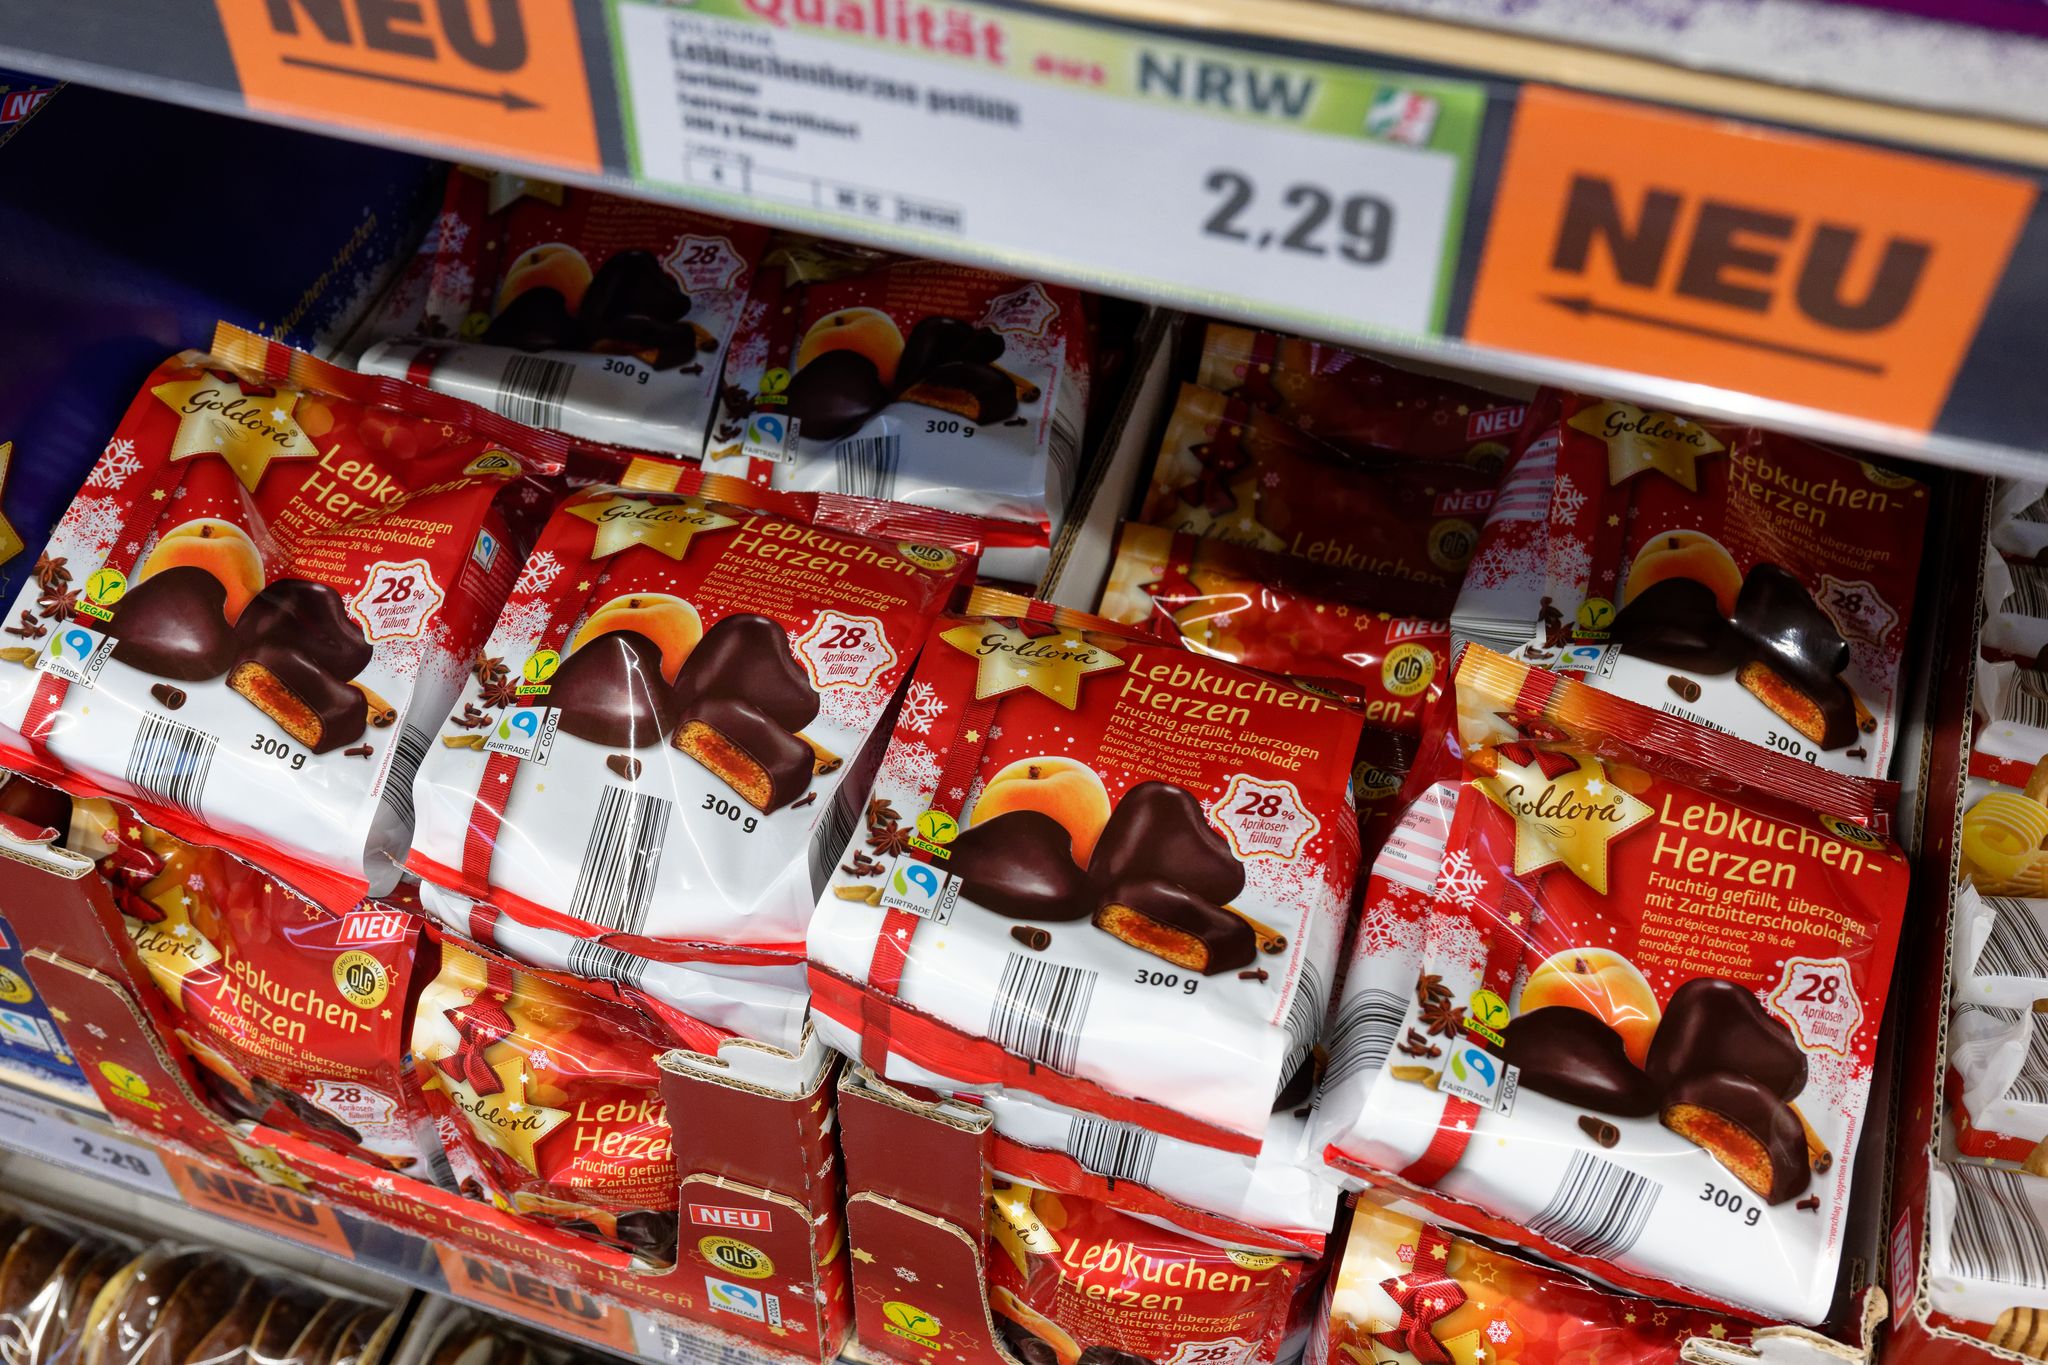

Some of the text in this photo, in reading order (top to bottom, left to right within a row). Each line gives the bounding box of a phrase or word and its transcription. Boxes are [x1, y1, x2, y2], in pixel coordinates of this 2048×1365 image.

[265, 0, 530, 72] NEU
[1032, 52, 1107, 86] aus
[1137, 50, 1319, 119] NRW
[1202, 168, 1395, 267] 2,29
[1549, 172, 1935, 333] NEU
[602, 358, 650, 385] 300 g
[181, 389, 296, 449] Goldora
[925, 420, 975, 438] 300 g
[1475, 407, 1525, 434] NEU
[1602, 410, 1706, 447] Goldora
[1729, 441, 1904, 513] Lebkuchen-
[1442, 496, 1492, 511] NEU
[1728, 464, 1826, 528] Herzen
[280, 508, 305, 529] mit
[384, 514, 453, 535] überzogen
[597, 504, 714, 527] Goldora
[327, 538, 350, 549] avec
[727, 532, 849, 577] Herzen
[740, 516, 932, 579] Lebkuchen-
[914, 544, 940, 561] DLG
[1819, 534, 1890, 562] überzogen
[703, 576, 742, 597] fourrage
[708, 570, 732, 585] Pains
[713, 561, 889, 613] mit Zartbitterschokolade
[720, 551, 908, 608] Fruchtig gefüllt, überzogen
[77, 600, 112, 622] VEGAN
[374, 602, 417, 619] Aprikosen-
[751, 594, 794, 611] chocolat
[380, 616, 410, 631] füllung
[1395, 620, 1448, 638] NEU
[91, 641, 114, 673] COCOA
[821, 650, 867, 666] Aprikosen-
[975, 633, 1098, 665] Goldora
[827, 662, 858, 677] füllung
[1128, 653, 1339, 714] Lebkuchen-
[1397, 655, 1421, 680] DLG
[517, 686, 551, 696] VEGAN
[1119, 677, 1251, 727] Herzen
[542, 712, 559, 748] COCOA
[1106, 724, 1201, 759] Pains d'épices avec
[1110, 713, 1302, 773] mit Zartbitterschokolade
[1114, 700, 1320, 761] Fruchtig gefüllt, überzogen
[1764, 730, 1802, 756] 300
[250, 733, 307, 771] 300 g
[486, 739, 532, 758] FAIRTRADE
[1099, 744, 1203, 778] enrobés chocolat
[1103, 733, 1201, 770] fourrage l'abricot,
[1134, 763, 1168, 784] forme
[701, 793, 759, 834] 300 g
[1505, 784, 1626, 823] Goldora
[1240, 817, 1289, 834] Aprikosen-
[1249, 830, 1283, 849] füllung
[1659, 793, 1883, 876] Lebkuchen-
[911, 837, 949, 859] VEGAN
[1651, 831, 1797, 890] Herzen
[883, 895, 931, 916] FAIRTRADE
[942, 880, 960, 910] COCOA
[1648, 871, 1867, 937] Fruchtig gefüllt, überzogen
[346, 915, 402, 940] NEU
[1641, 910, 1766, 943] Pains d'épices avec 28
[1644, 892, 1854, 949] mit Zartbitterschokolade
[128, 926, 204, 960] ldora
[1638, 937, 1753, 968] enrobés chocolat
[1640, 923, 1750, 955] fourrage l'abricot,
[336, 954, 386, 991] GEPRÜFTE QUALITÄT
[350, 963, 373, 993] DLG
[1134, 969, 1200, 995] 300 g
[1637, 950, 1765, 982] noir, forme cœur
[224, 945, 372, 1034] Lebkuchen-
[343, 986, 376, 1006] TEST 2024
[216, 974, 307, 1044] Herzen
[1801, 1003, 1844, 1024] Aprikosen-
[209, 1005, 259, 1039] Fruchtig
[259, 1033, 298, 1058] gefüllt,
[301, 1048, 368, 1077] überzogen
[1467, 1018, 1502, 1046] VEGAN
[1810, 1020, 1839, 1042] füllung
[208, 1022, 227, 1039] mit
[229, 1030, 358, 1081] Zartbitterschokolade
[1441, 1079, 1491, 1106] FAIRTRADE
[1503, 1069, 1519, 1100] COCOA
[451, 1091, 546, 1131] Goldora
[570, 1175, 593, 1188] mit
[571, 1156, 625, 1178] Fruchtig
[1834, 1164, 1847, 1201] Suggestion
[187, 1164, 320, 1226] NEU
[1699, 1181, 1763, 1228] 300 g
[700, 1207, 761, 1228] NEU
[338, 1180, 694, 1309] Gefüllte Lebkuchen-Herzen
[722, 1246, 753, 1269] DLG
[1063, 1238, 1270, 1293] Lebkuchen-
[463, 1256, 601, 1321] NEU
[1058, 1268, 1184, 1312] Herzen
[712, 1302, 762, 1320] FAIRTRADE
[1056, 1286, 1256, 1326] Fruchtig gefüllt, überzogen
[1083, 1306, 1242, 1333] Zartbitterschokolade
[886, 1326, 938, 1350] VEGAN
